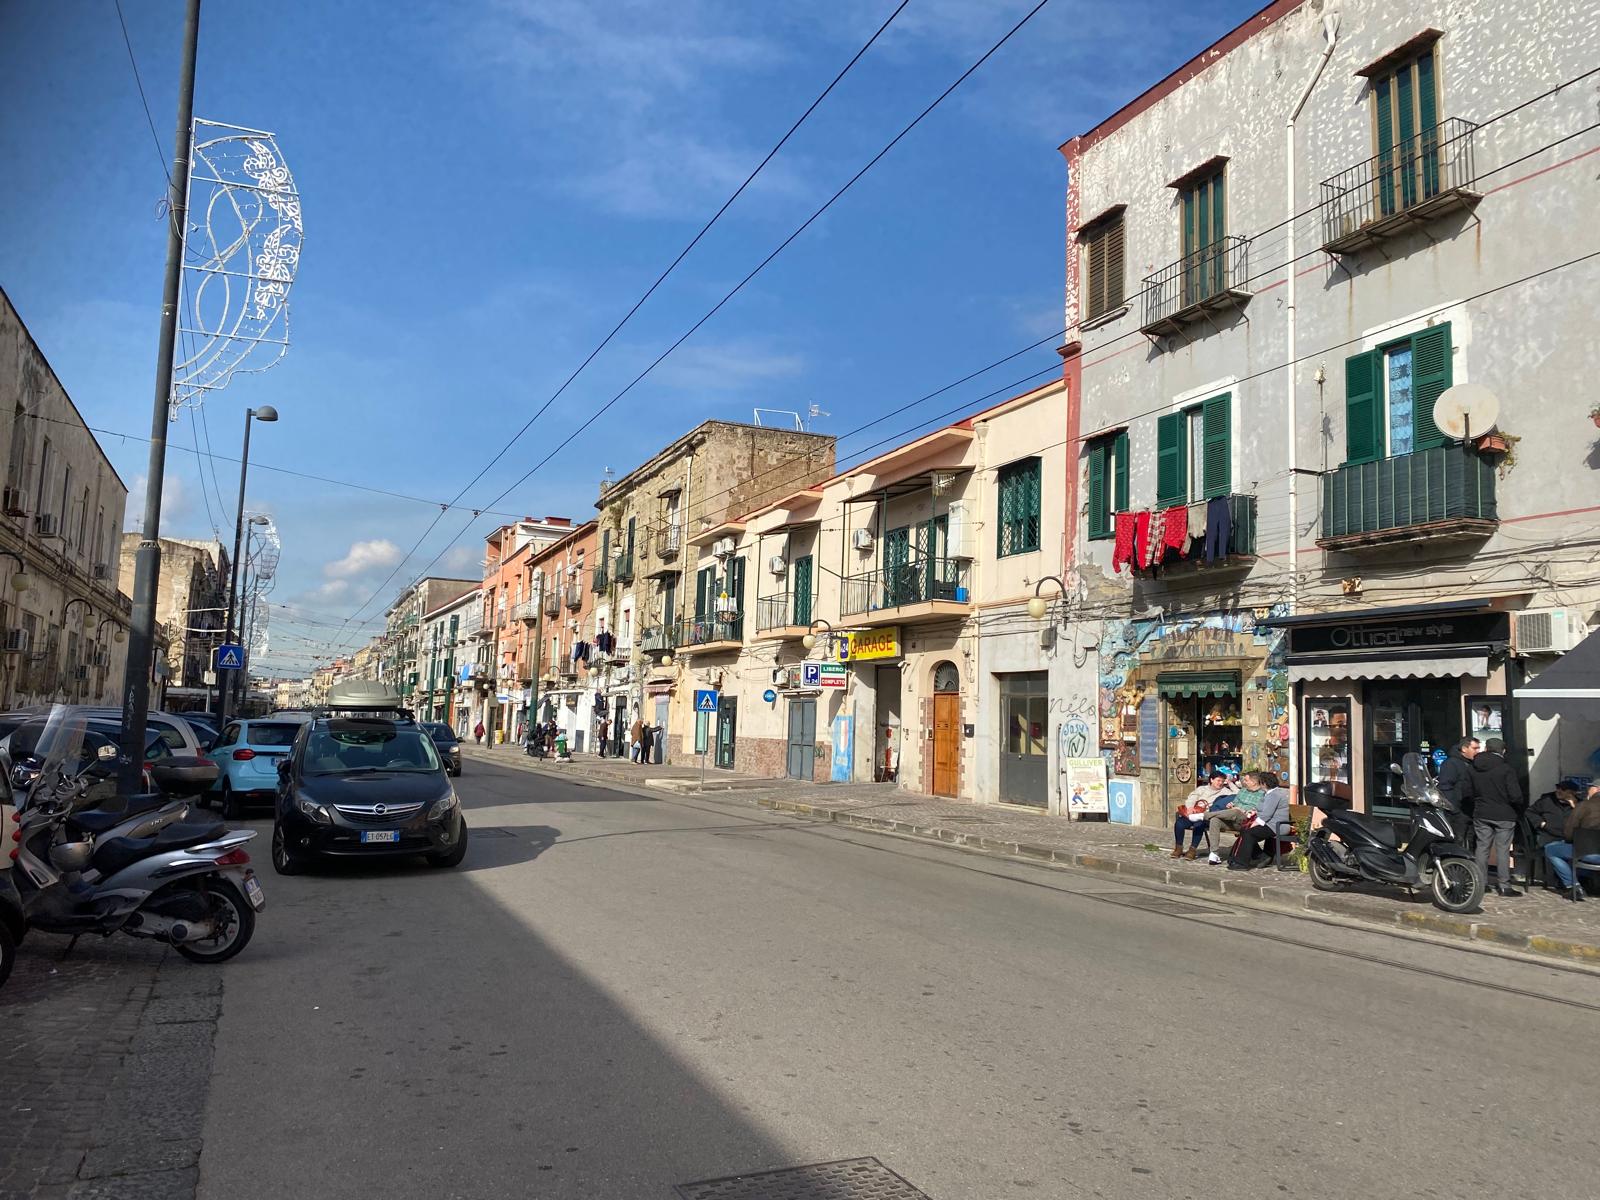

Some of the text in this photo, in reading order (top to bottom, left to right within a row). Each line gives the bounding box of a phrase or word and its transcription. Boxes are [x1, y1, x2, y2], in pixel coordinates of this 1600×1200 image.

[1401, 626, 1422, 636] new
[1426, 624, 1454, 638] style
[851, 633, 893, 654] GARAGE
[808, 667, 817, 678] P
[1069, 759, 1103, 767] GULLIVER
